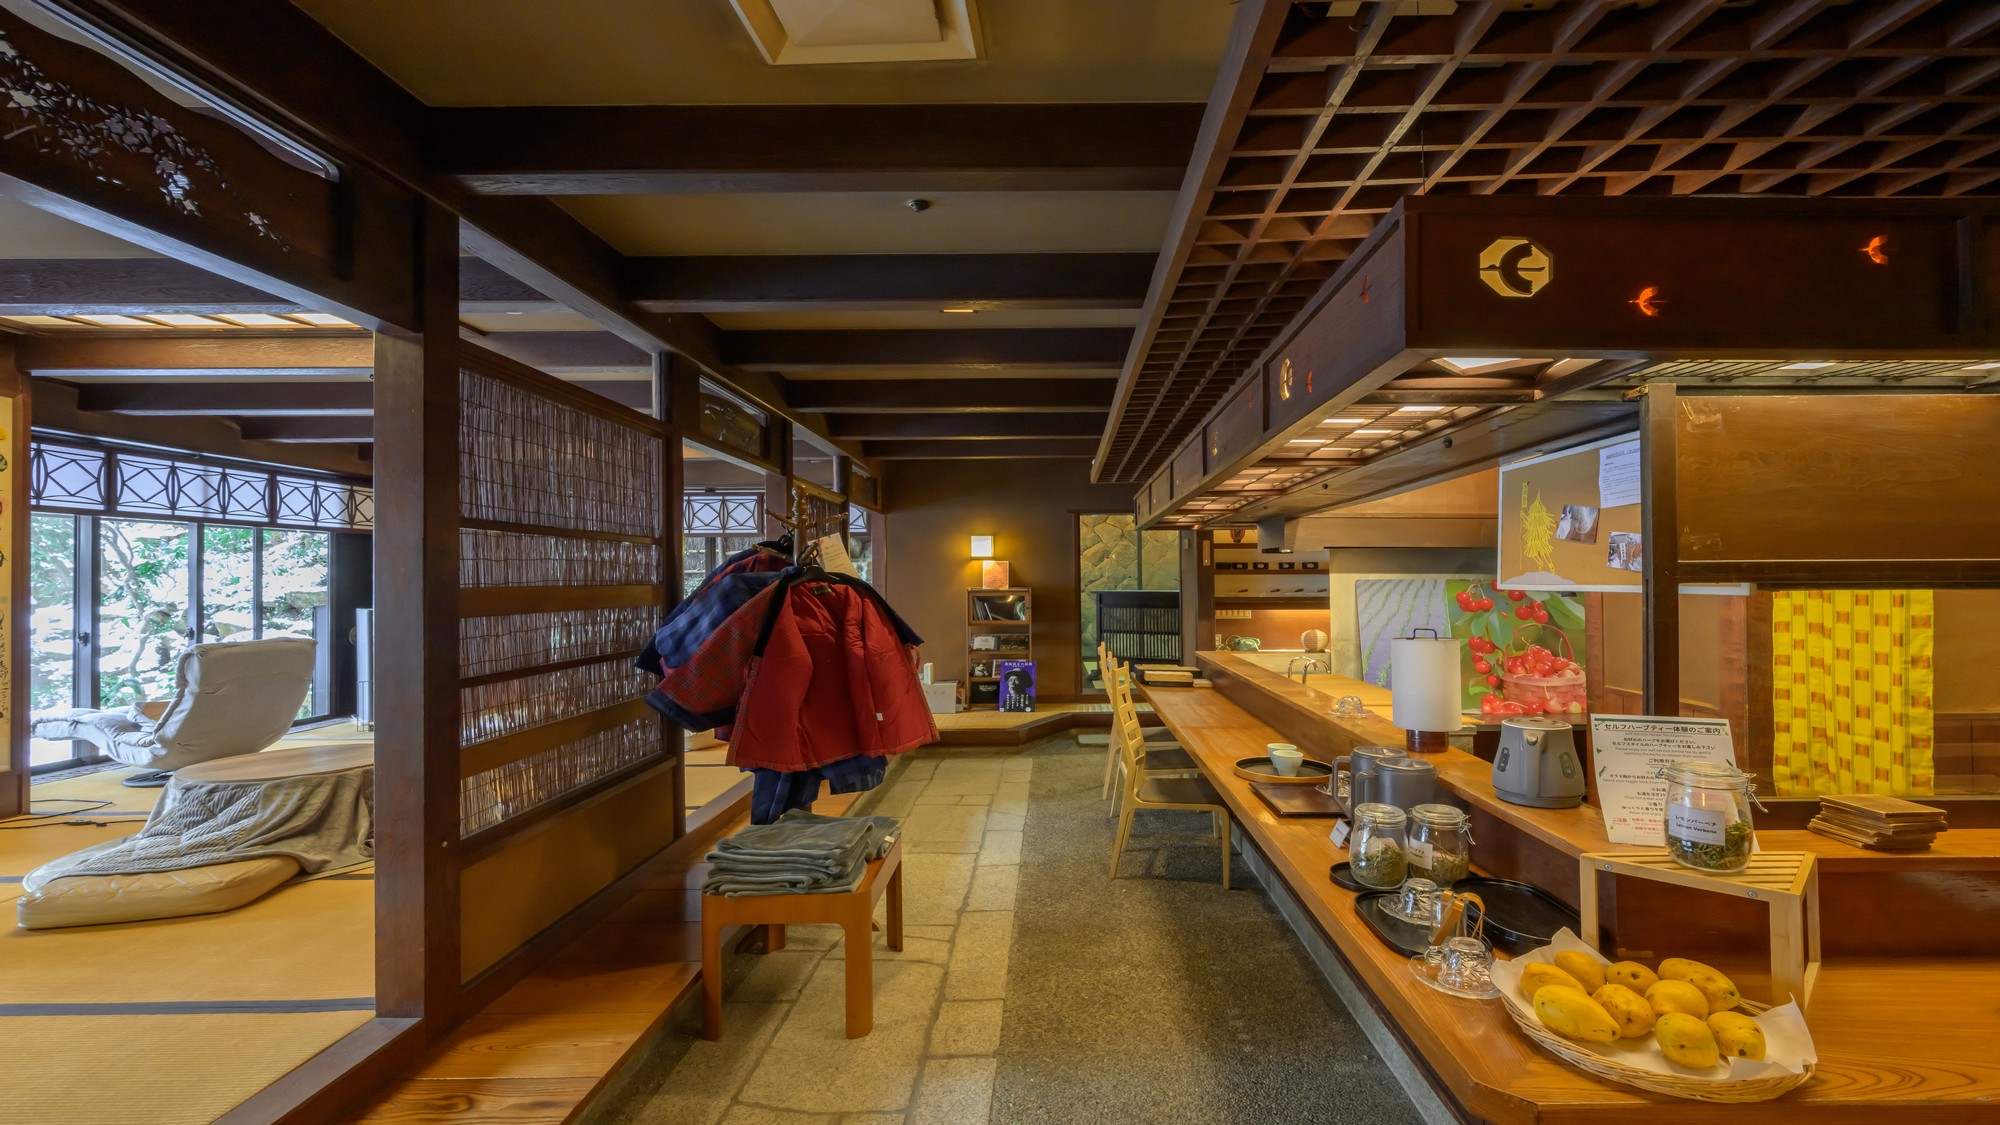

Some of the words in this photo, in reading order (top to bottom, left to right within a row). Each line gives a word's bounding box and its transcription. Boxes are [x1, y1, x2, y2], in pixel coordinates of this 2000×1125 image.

[1604, 724, 1721, 734] セルフハーブティー体験のご案内
[1675, 815, 1717, 827] レモンバーベナ
[1693, 826, 1717, 834] Verbena
